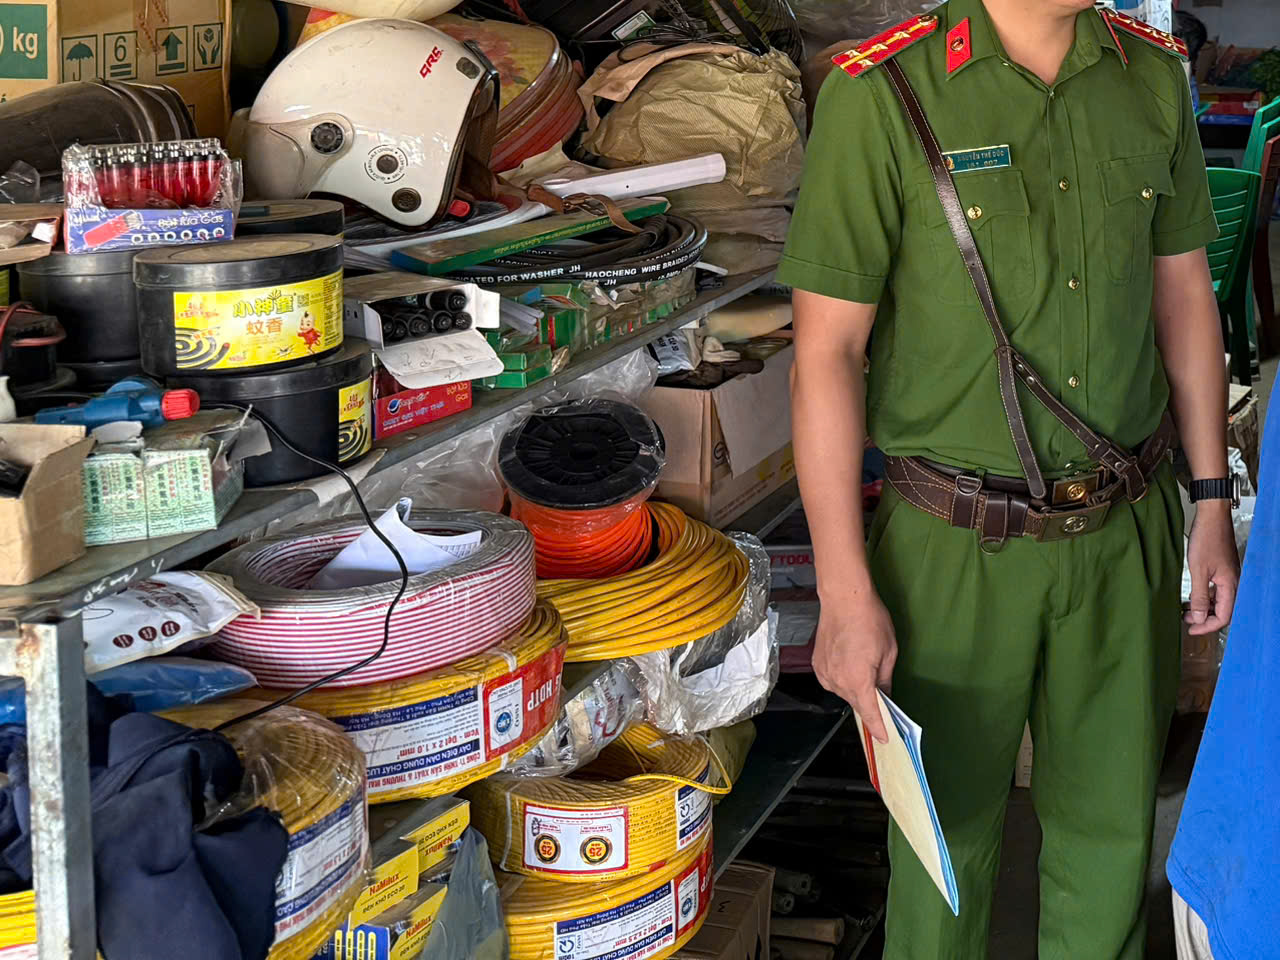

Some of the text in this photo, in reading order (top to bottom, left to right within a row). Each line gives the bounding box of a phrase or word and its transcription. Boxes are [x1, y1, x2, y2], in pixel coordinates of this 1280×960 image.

[12, 26, 38, 59] kg
[114, 35, 128, 62] 6
[497, 275, 518, 283] FOR
[520, 268, 564, 281] WASHER
[569, 264, 581, 274] JH
[585, 268, 637, 278] HAOCHENG
[641, 263, 661, 274] WIRE
[662, 255, 689, 270] BRAIDED
[527, 679, 553, 711] HDTP
[424, 835, 454, 856] NaMilux
[541, 844, 553, 856] 25
[589, 846, 602, 857] 25
[369, 873, 400, 896] NaMilux
[406, 916, 433, 939] NaMilux
